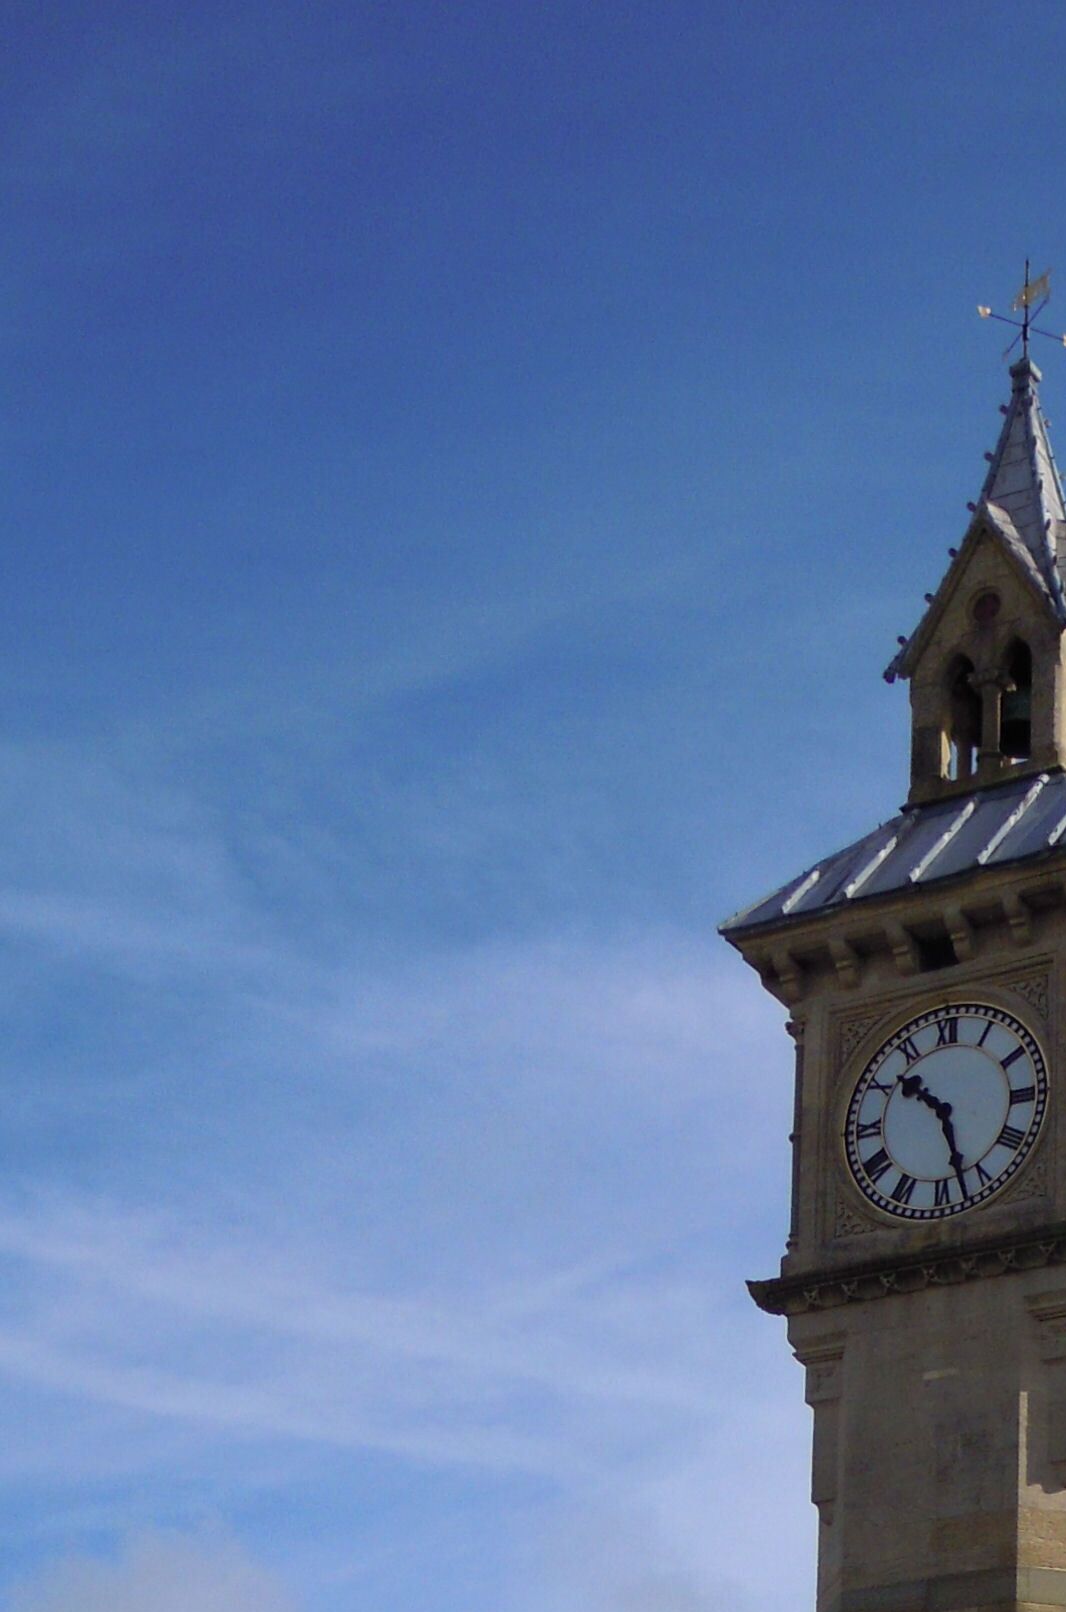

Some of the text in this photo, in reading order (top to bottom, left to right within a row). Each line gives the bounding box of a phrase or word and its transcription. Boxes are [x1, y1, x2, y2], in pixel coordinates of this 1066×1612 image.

[936, 1017, 958, 1047] XII
[976, 1020, 994, 1047] I
[896, 1037, 922, 1065] XI
[1000, 1044, 1026, 1070] II
[868, 1076, 893, 1096] X
[1009, 1086, 1036, 1105] III
[857, 1117, 882, 1140] IX
[997, 1124, 1027, 1150] IIII
[861, 1148, 893, 1184] VIII
[975, 1163, 993, 1188] V
[891, 1173, 917, 1205] VII
[934, 1180, 951, 1207] VI
